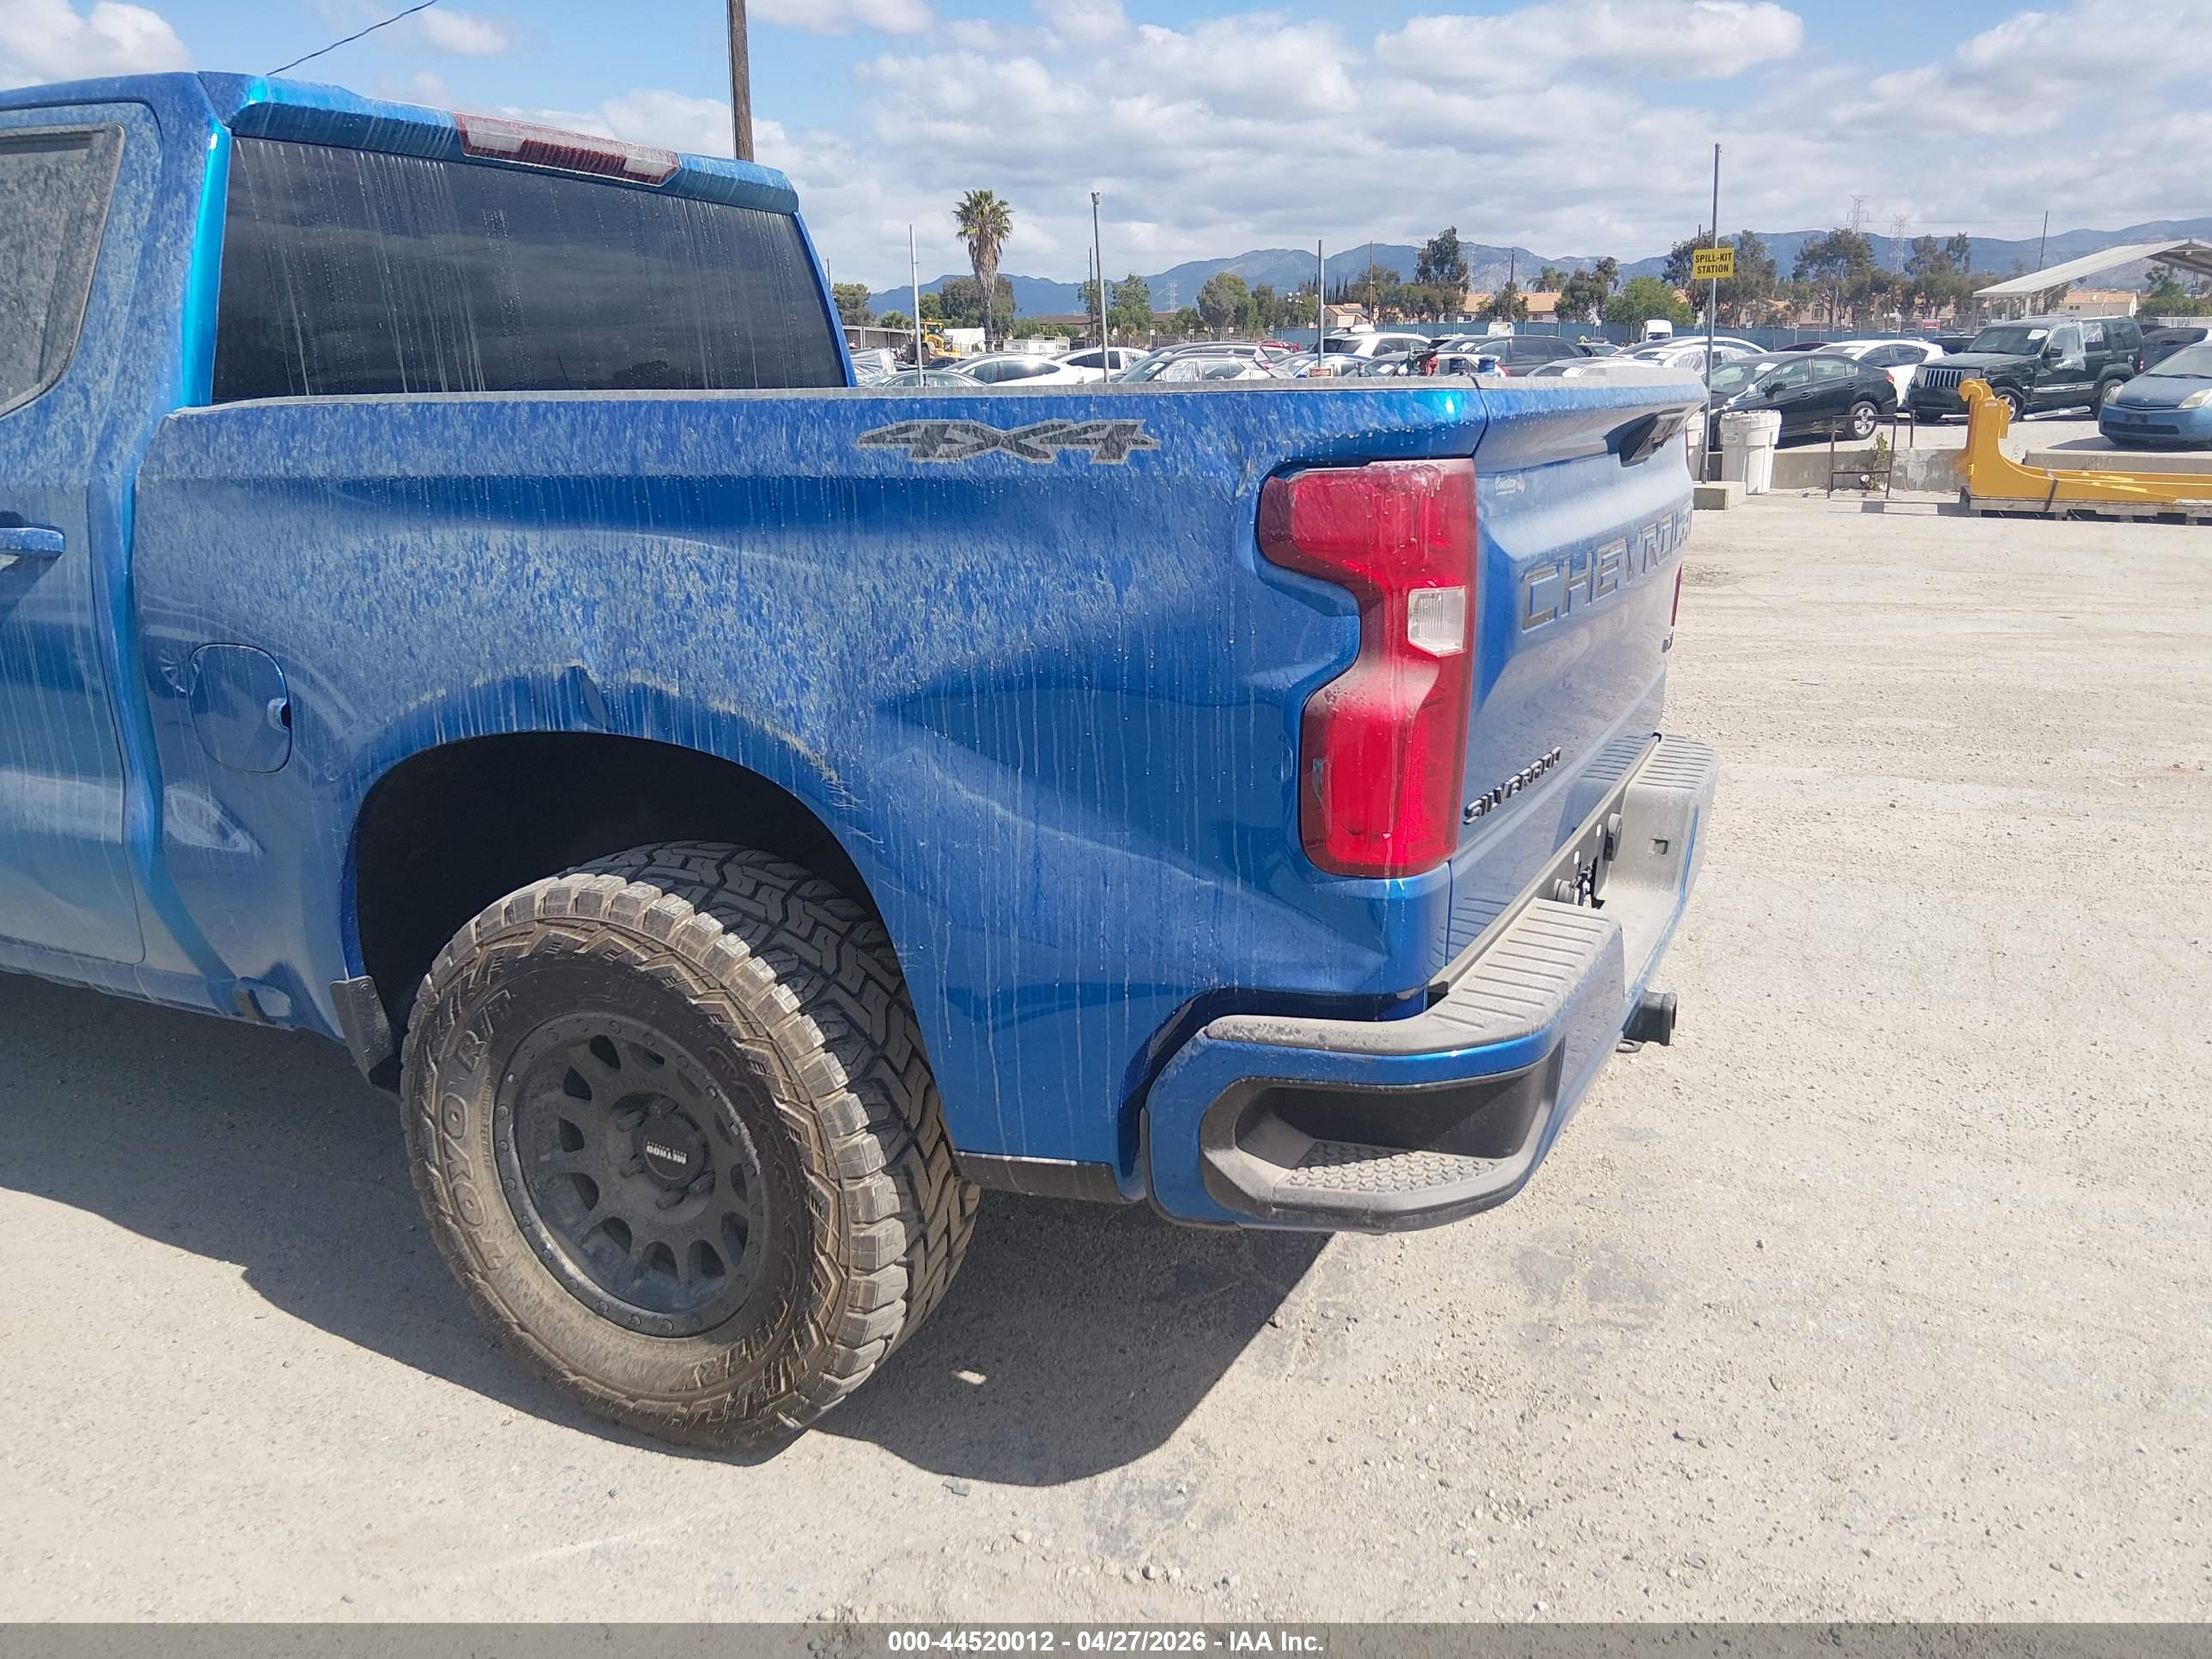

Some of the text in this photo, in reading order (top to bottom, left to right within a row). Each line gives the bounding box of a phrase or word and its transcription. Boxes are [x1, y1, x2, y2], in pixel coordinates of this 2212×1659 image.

[1695, 252, 1732, 264] SPILL-KIT
[1697, 264, 1729, 274] STATION
[1462, 745, 1562, 825] SILVERADO
[441, 1091, 507, 1271] TOYO
